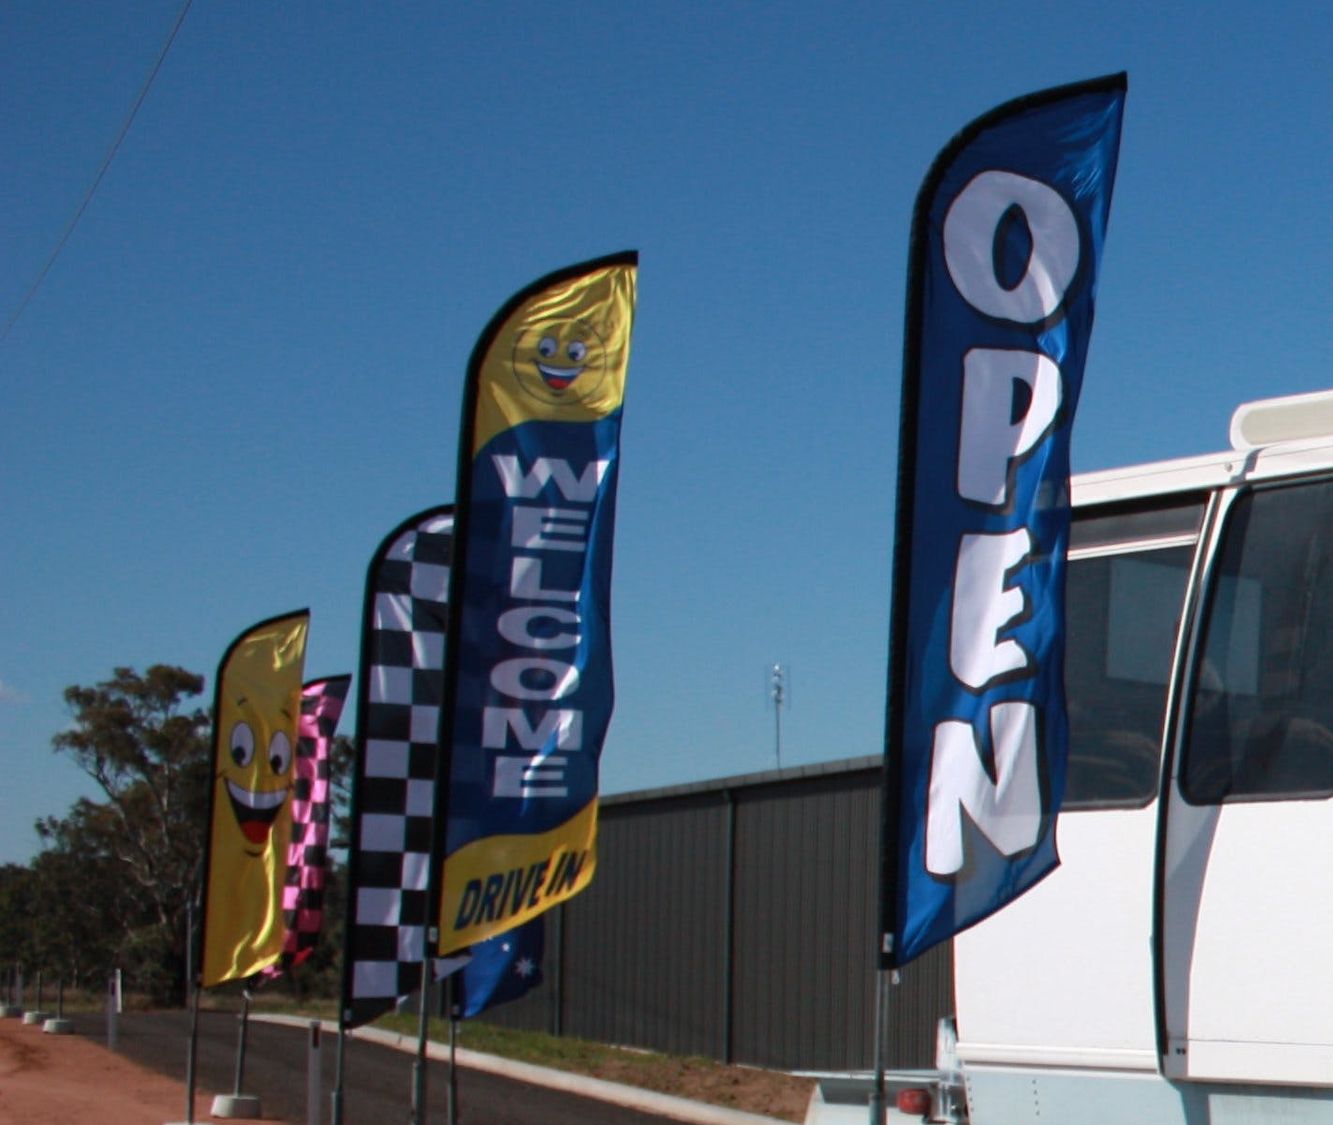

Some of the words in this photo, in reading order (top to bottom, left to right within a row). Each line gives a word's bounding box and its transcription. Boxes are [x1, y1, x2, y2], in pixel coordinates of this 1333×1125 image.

[481, 454, 609, 798] WELCOME
[922, 167, 1082, 878] OPEN
[454, 858, 552, 931] DRIVE
[546, 850, 587, 896] IN
